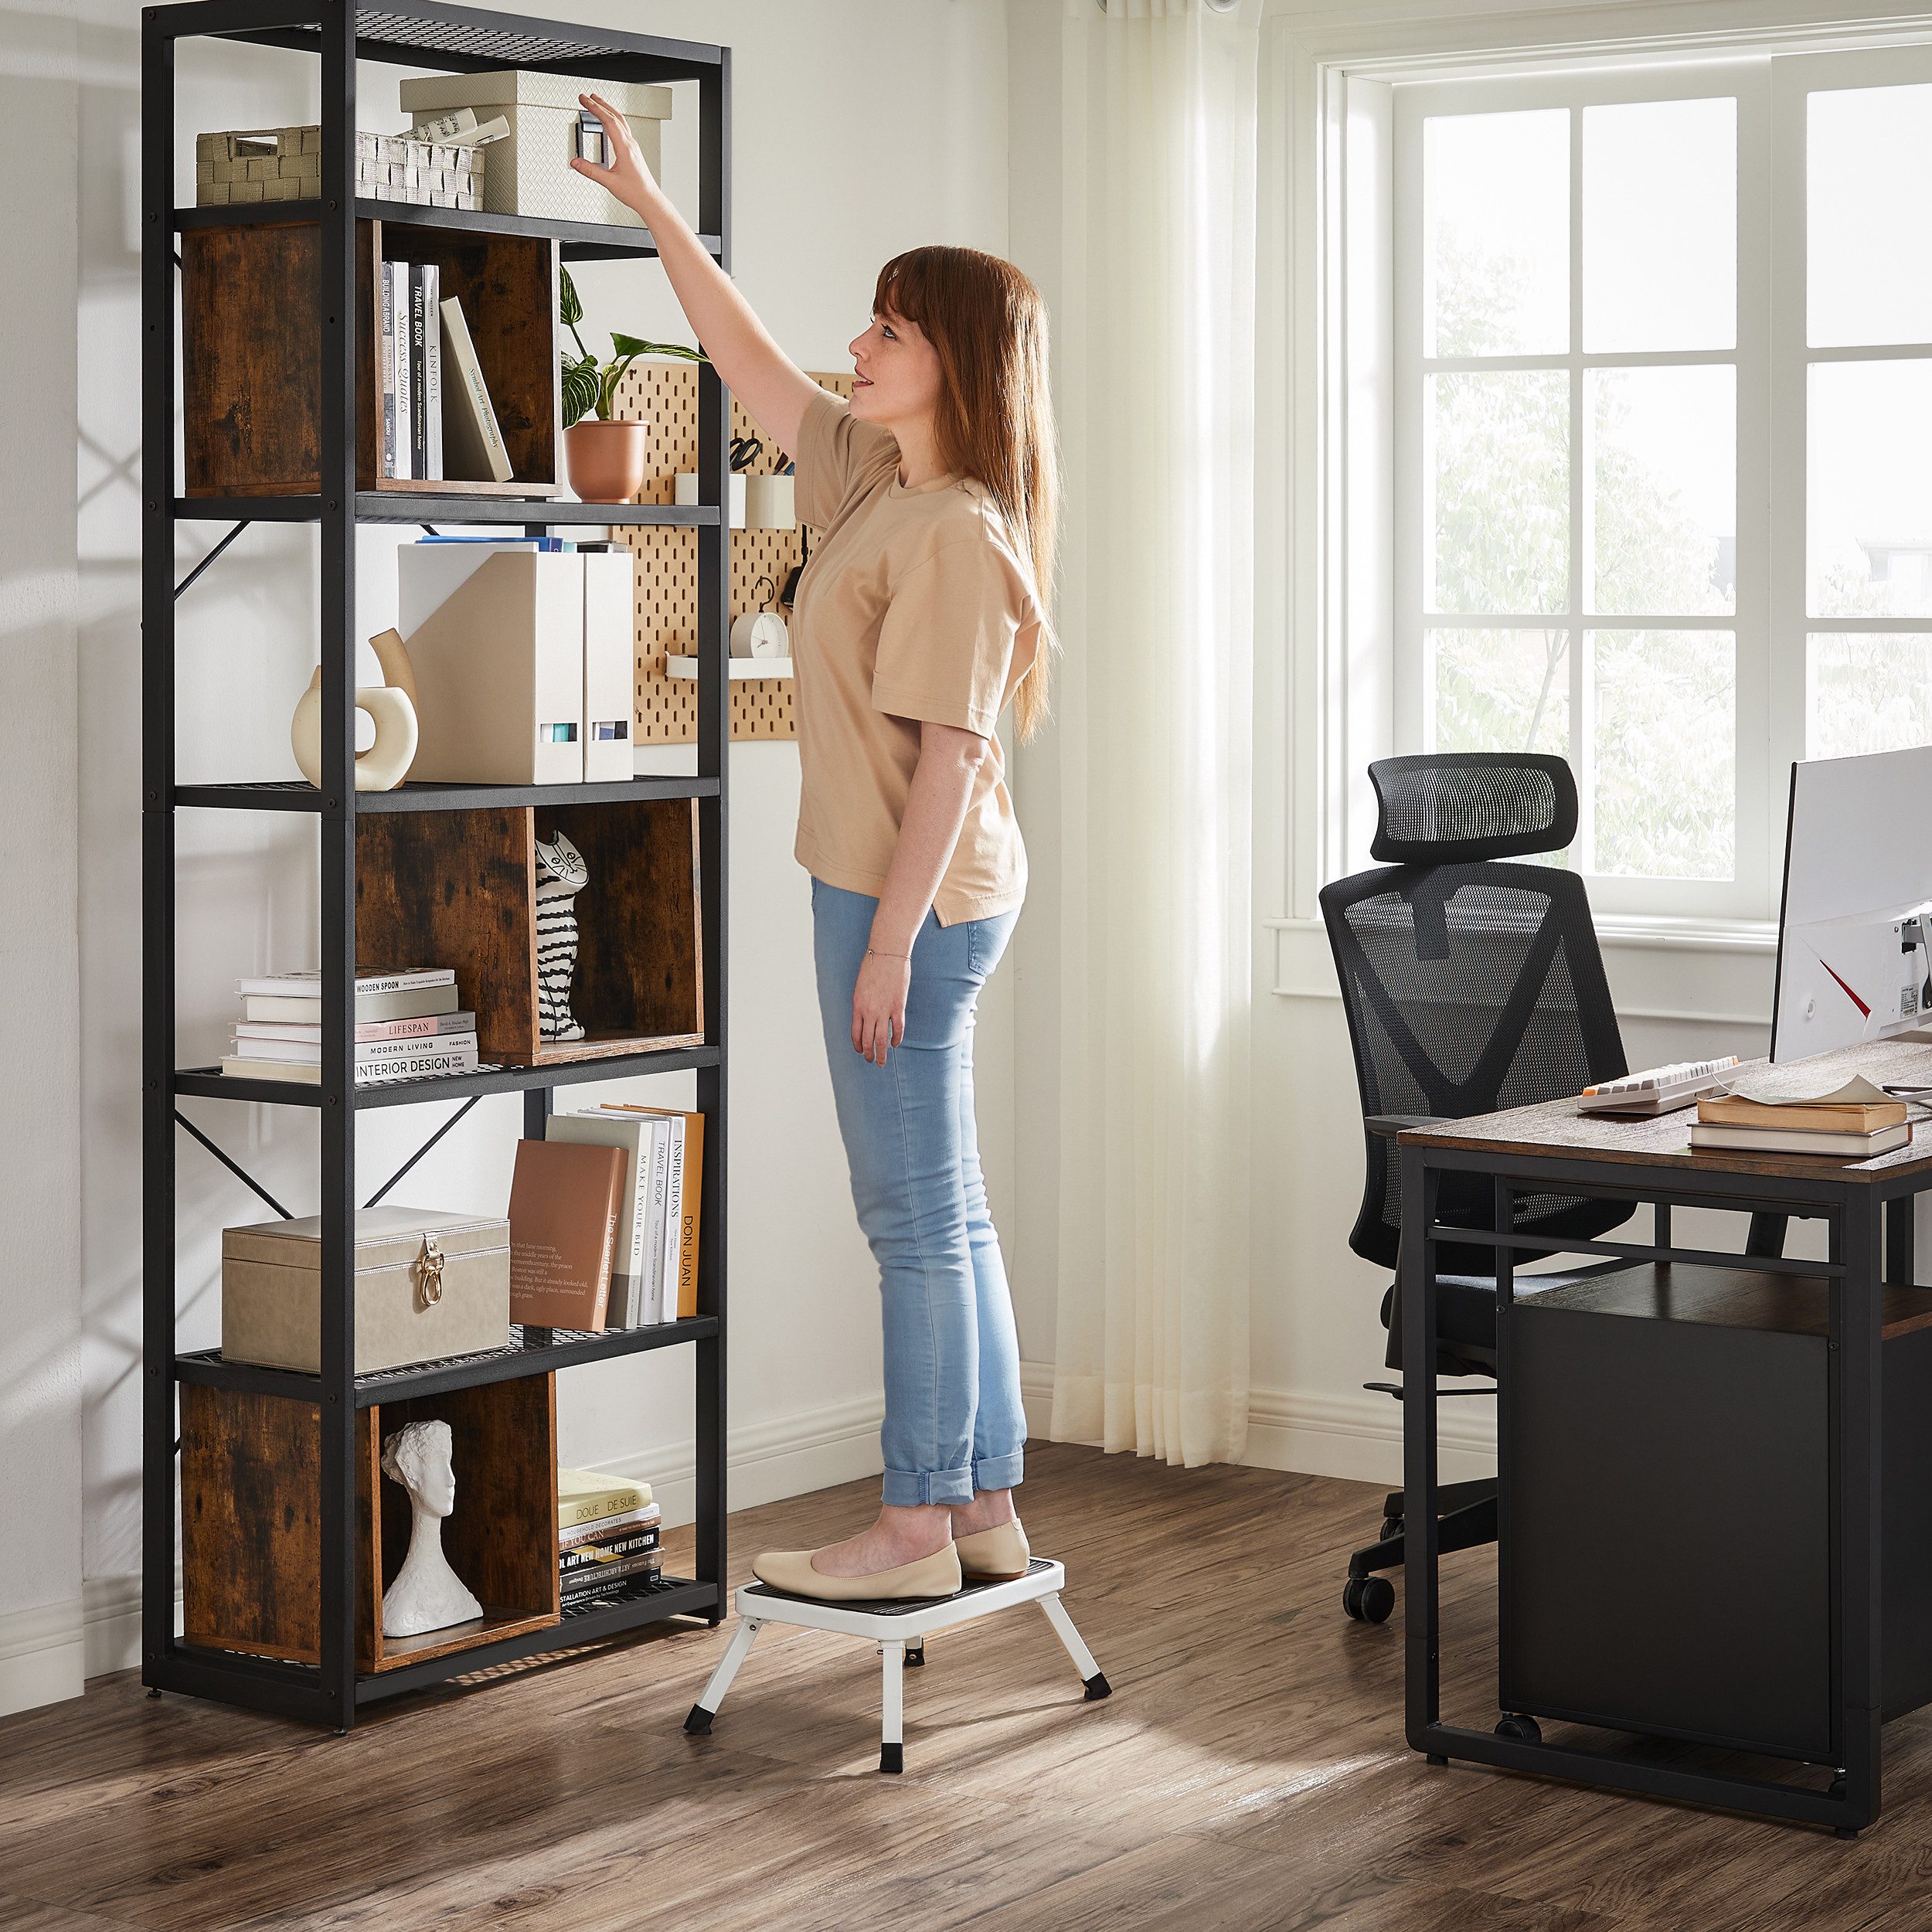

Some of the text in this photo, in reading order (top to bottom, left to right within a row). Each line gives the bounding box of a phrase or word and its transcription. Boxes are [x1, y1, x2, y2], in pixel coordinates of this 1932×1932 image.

[414, 285, 423, 348] TRAVEL BOOK
[398, 312, 409, 413] Success Quotes
[469, 368, 482, 392] Symbol
[481, 407, 498, 448] Photography
[356, 981, 399, 993] WOODEN SPOON
[389, 1022, 429, 1035] LIFESPAN
[370, 1042, 434, 1054] MODERN LIVING
[355, 1057, 450, 1077] INTERIOR DESIGN
[638, 1155, 647, 1190] MAKE
[655, 1141, 665, 1206] TRAVEL BOOK
[672, 1140, 682, 1217] INSPIRATIONS
[635, 1196, 644, 1229] YOUR
[597, 1213, 617, 1308] The Scarlet Letter
[682, 1216, 693, 1286] DON JUAN
[576, 1495, 637, 1519] DOUE DE SUIE
[566, 1525, 594, 1536] HOUSEHOLD
[595, 1517, 621, 1529] DECORATES
[570, 1535, 587, 1546] YOU
[587, 1530, 604, 1541] CAN
[566, 1554, 580, 1567] ART
[580, 1550, 594, 1563] NEW
[595, 1545, 613, 1559] HOME
[614, 1542, 627, 1553] NEW
[628, 1533, 655, 1550] KITCHEN
[567, 1598, 586, 1607] Experience
[600, 1590, 620, 1598] Technology
[607, 1580, 628, 1591] DESIGN
